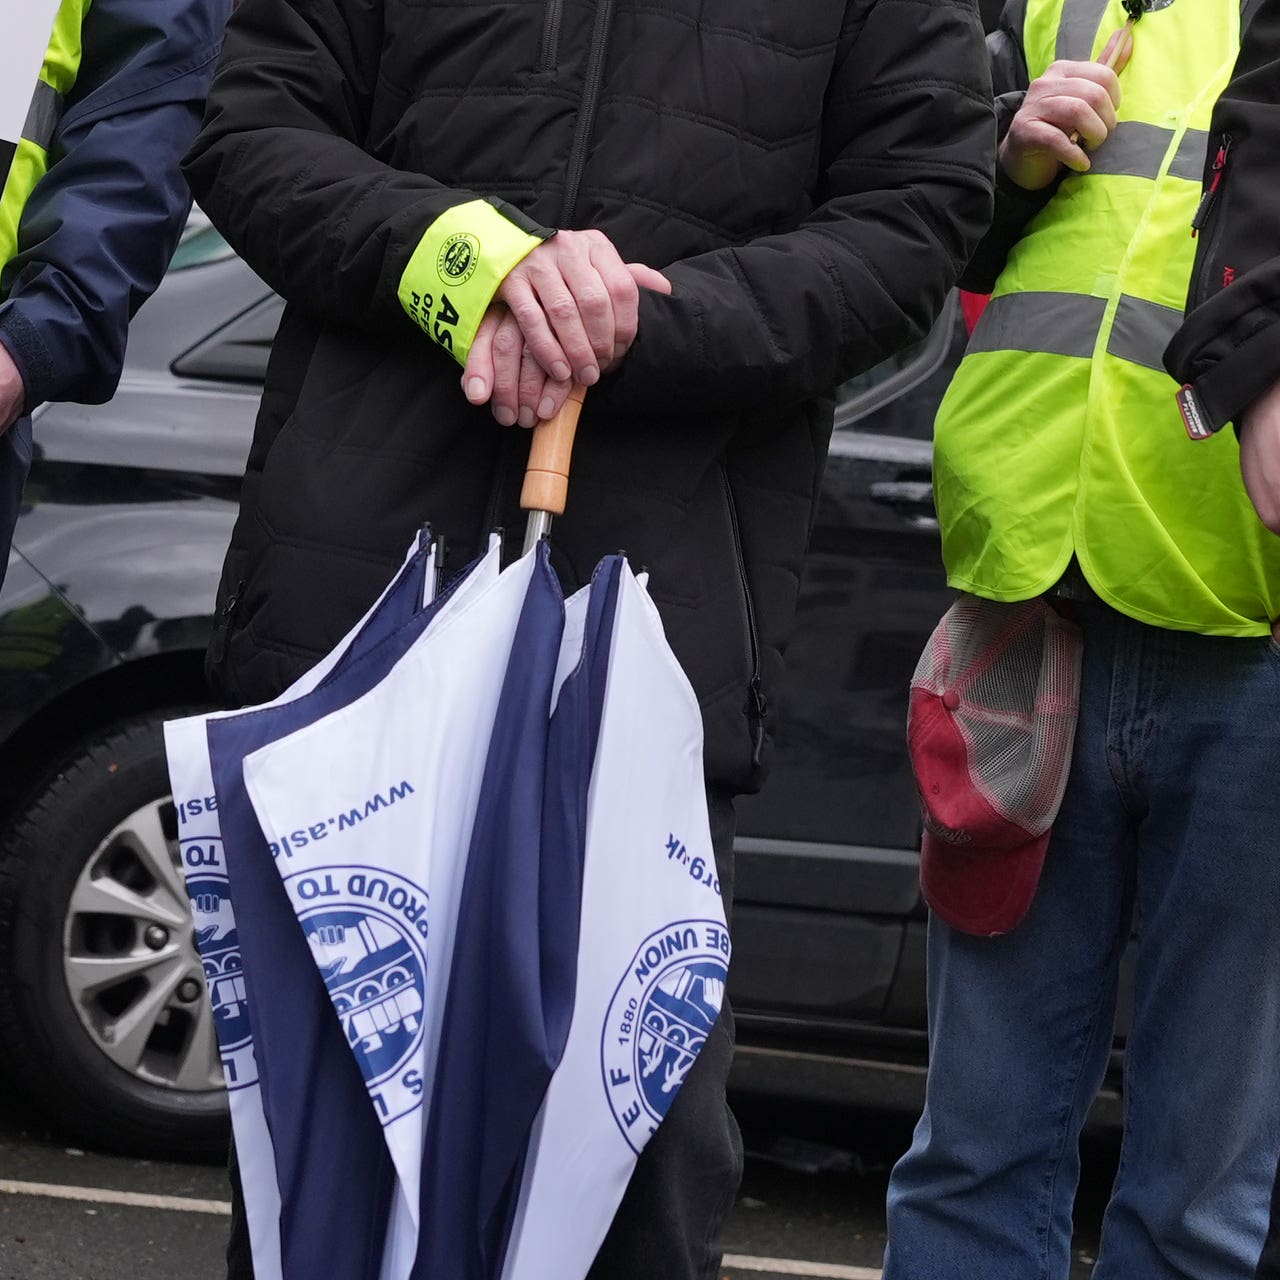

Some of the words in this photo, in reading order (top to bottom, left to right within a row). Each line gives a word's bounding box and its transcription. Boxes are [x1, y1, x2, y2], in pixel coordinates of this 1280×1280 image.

[185, 844, 220, 867] TO
[296, 874, 341, 900] TO
[634, 928, 699, 985] UNION
[618, 997, 638, 1046] 1880
